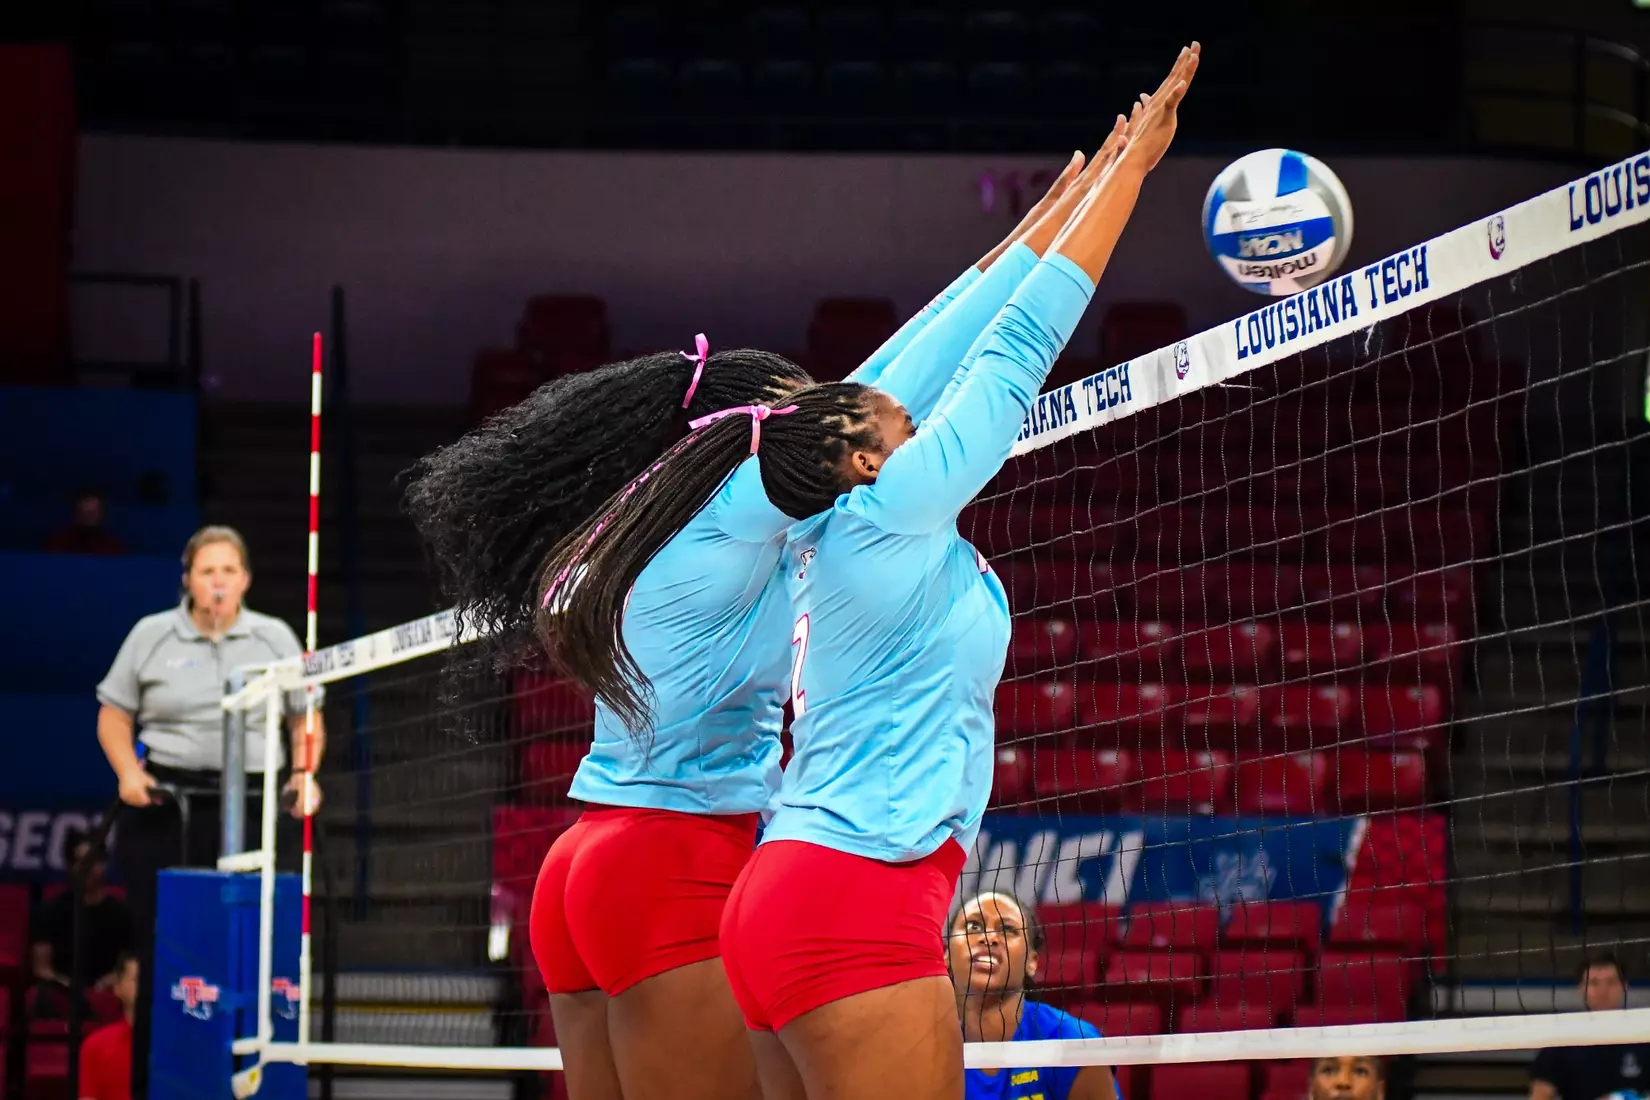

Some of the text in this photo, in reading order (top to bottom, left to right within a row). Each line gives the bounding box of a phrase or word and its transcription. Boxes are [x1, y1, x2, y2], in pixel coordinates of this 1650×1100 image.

[1238, 251, 1318, 279] molten
[1235, 244, 1430, 361] LOUISIANA TECH
[1082, 362, 1132, 416] TECH
